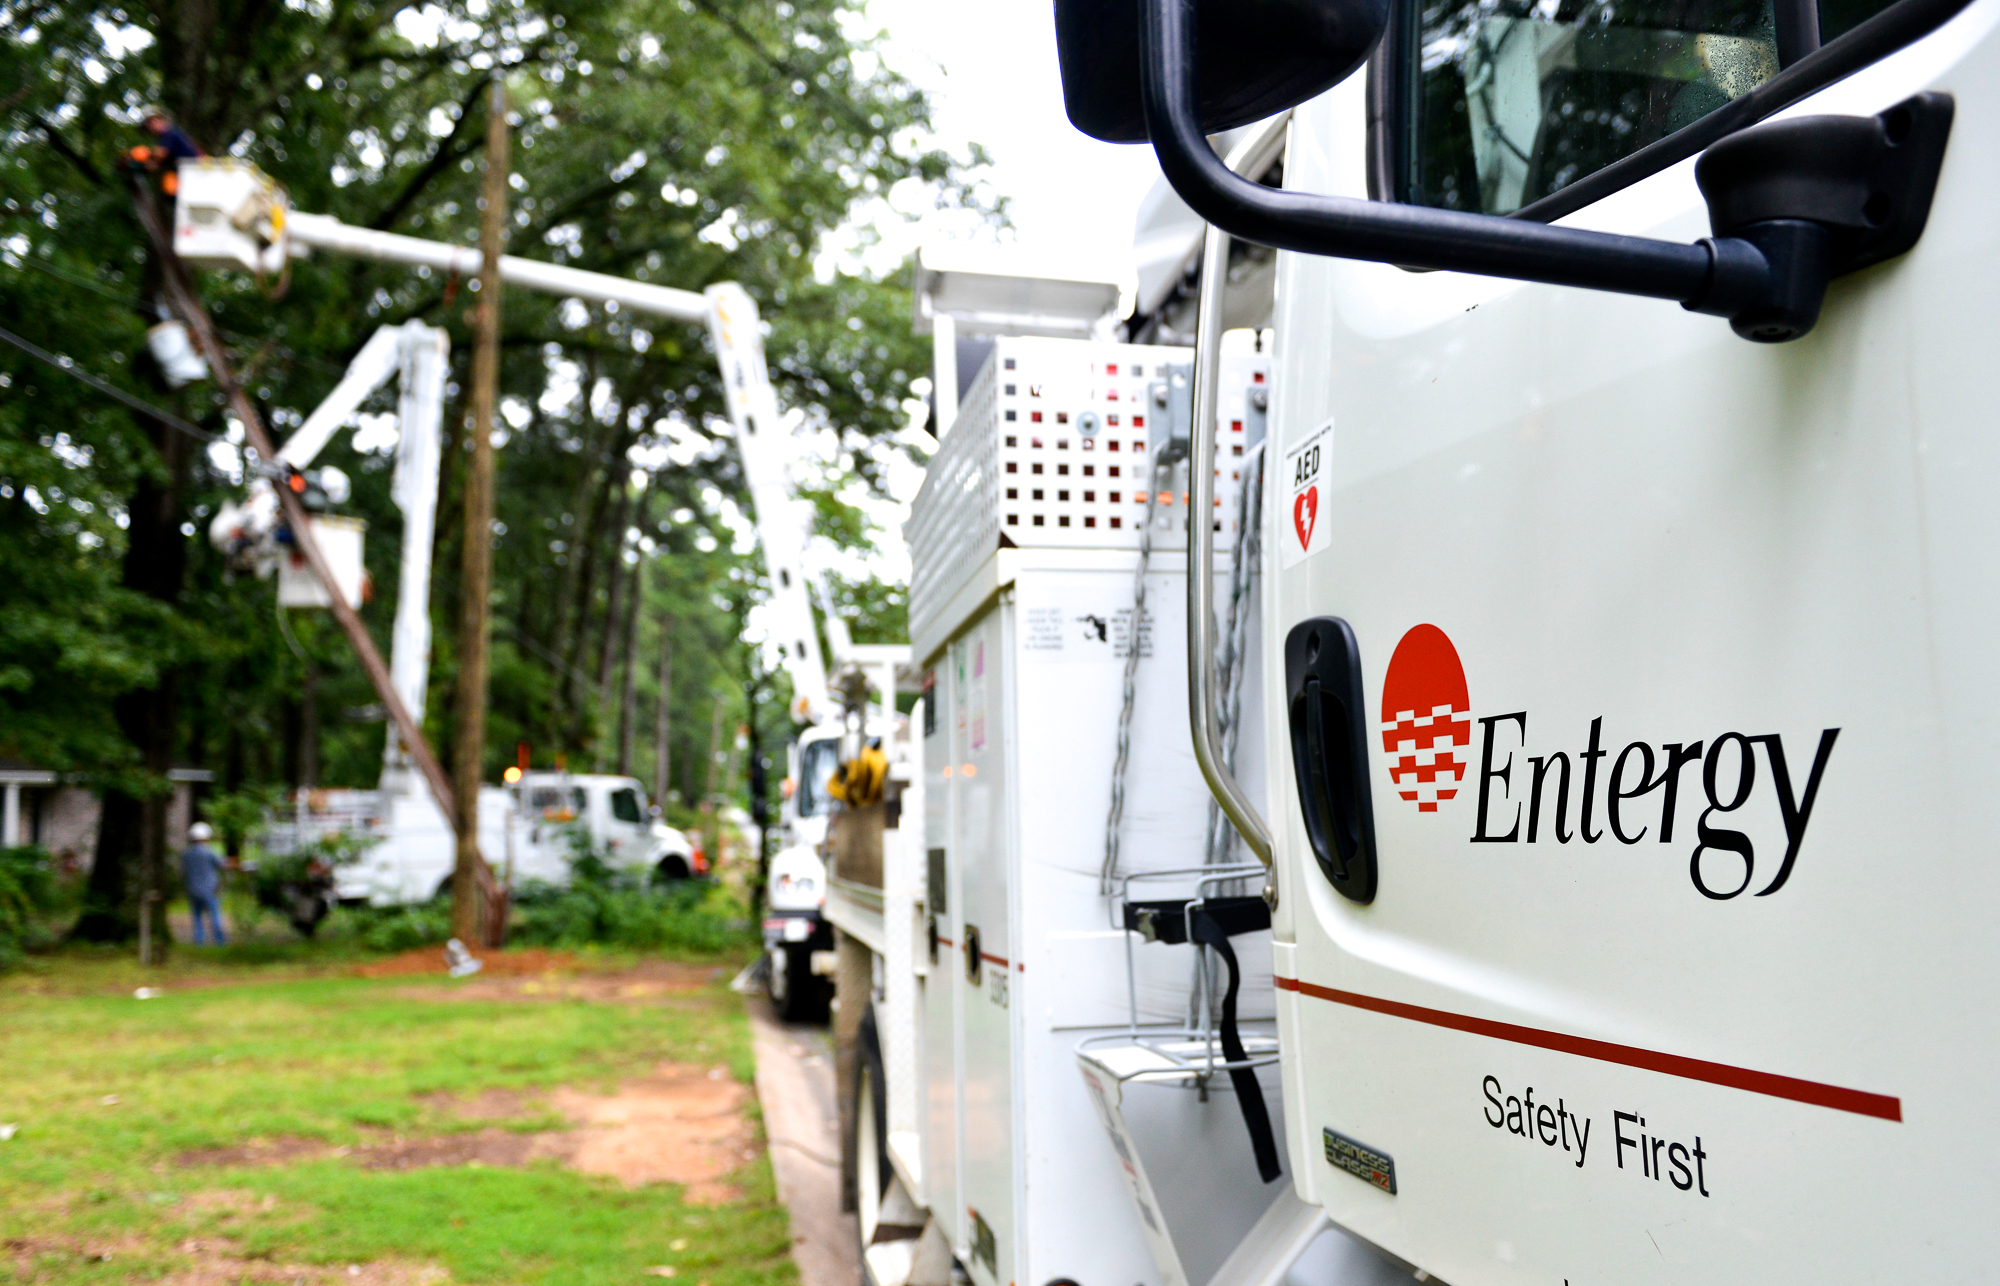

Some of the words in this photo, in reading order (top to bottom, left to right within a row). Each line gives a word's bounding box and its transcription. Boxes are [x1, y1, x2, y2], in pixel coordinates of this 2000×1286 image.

[1294, 444, 1320, 487] AED
[1470, 711, 1842, 900] Entergy
[1482, 1074, 1591, 1168] Safety
[1613, 1109, 1710, 1198] First
